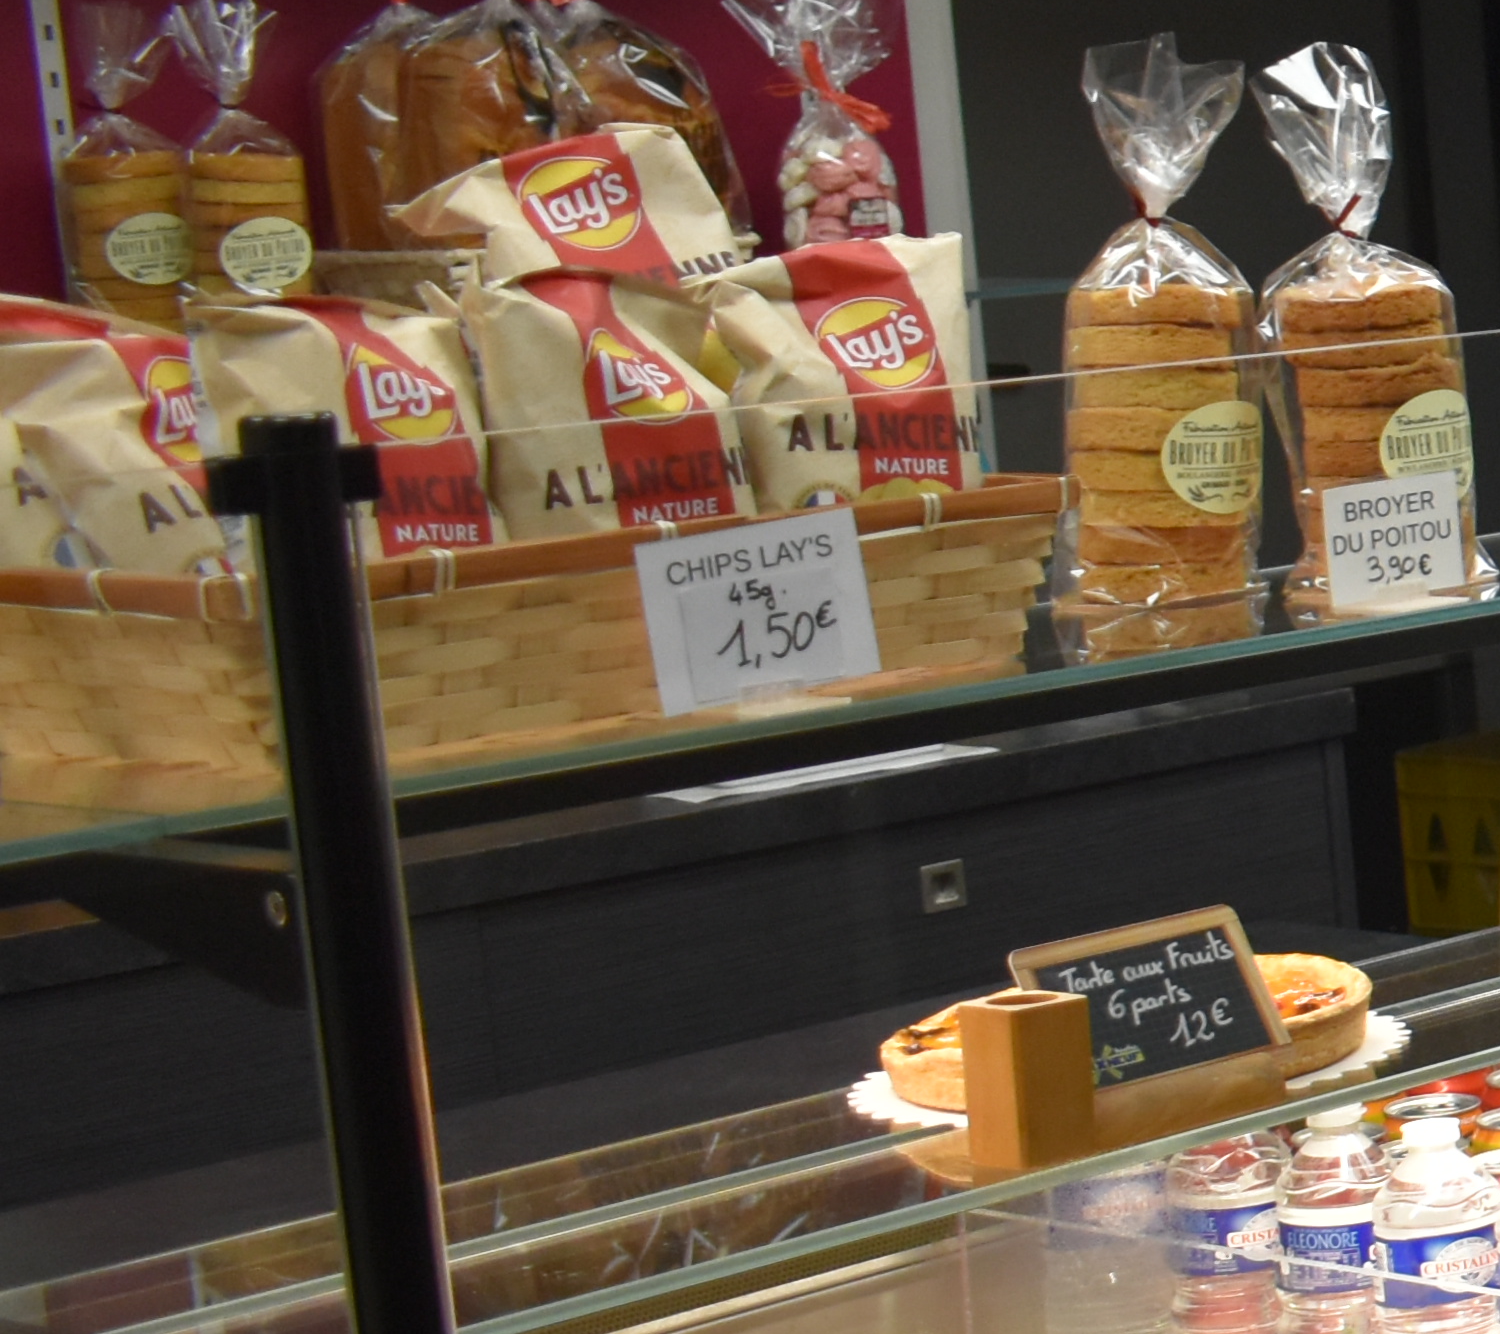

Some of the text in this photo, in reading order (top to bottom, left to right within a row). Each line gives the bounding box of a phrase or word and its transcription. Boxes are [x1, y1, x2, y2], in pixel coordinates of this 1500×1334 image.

[527, 168, 631, 235] Lay's
[826, 310, 926, 369] Lay's
[1169, 439, 1217, 466] BROYER
[1222, 438, 1238, 465] DU
[1387, 432, 1433, 461] BROYER
[874, 456, 949, 476] NATURE
[633, 497, 719, 524] NATURE
[1344, 490, 1436, 522] BROYER
[395, 523, 480, 544] NATURE
[1333, 518, 1452, 556] DU POITOU
[666, 533, 834, 587] CHIPS LAY'S
[1366, 553, 1432, 586] 3,90€
[716, 600, 838, 669] 1,50€
[1058, 930, 1235, 993] Tarte aux Fruits
[1108, 979, 1193, 1026] 6 parts
[1287, 1230, 1360, 1250] ELEONORE
